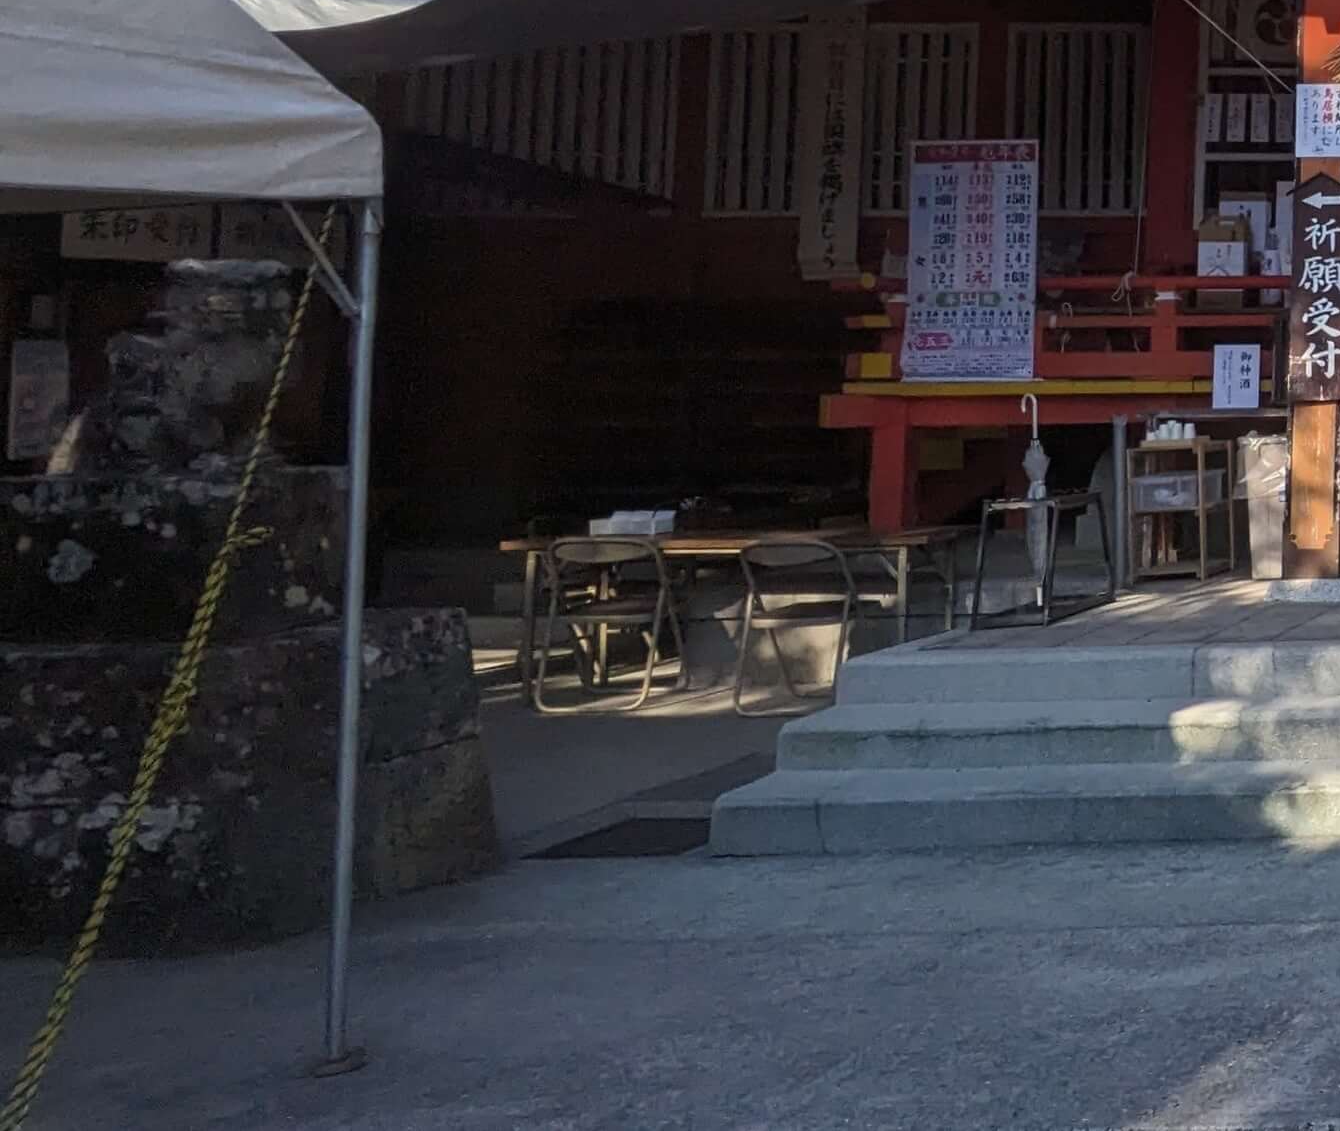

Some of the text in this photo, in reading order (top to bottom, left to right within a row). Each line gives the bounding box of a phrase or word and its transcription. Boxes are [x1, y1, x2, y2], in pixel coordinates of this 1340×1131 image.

[1311, 89, 1322, 135] あります
[1239, 351, 1252, 391] 御神酒
